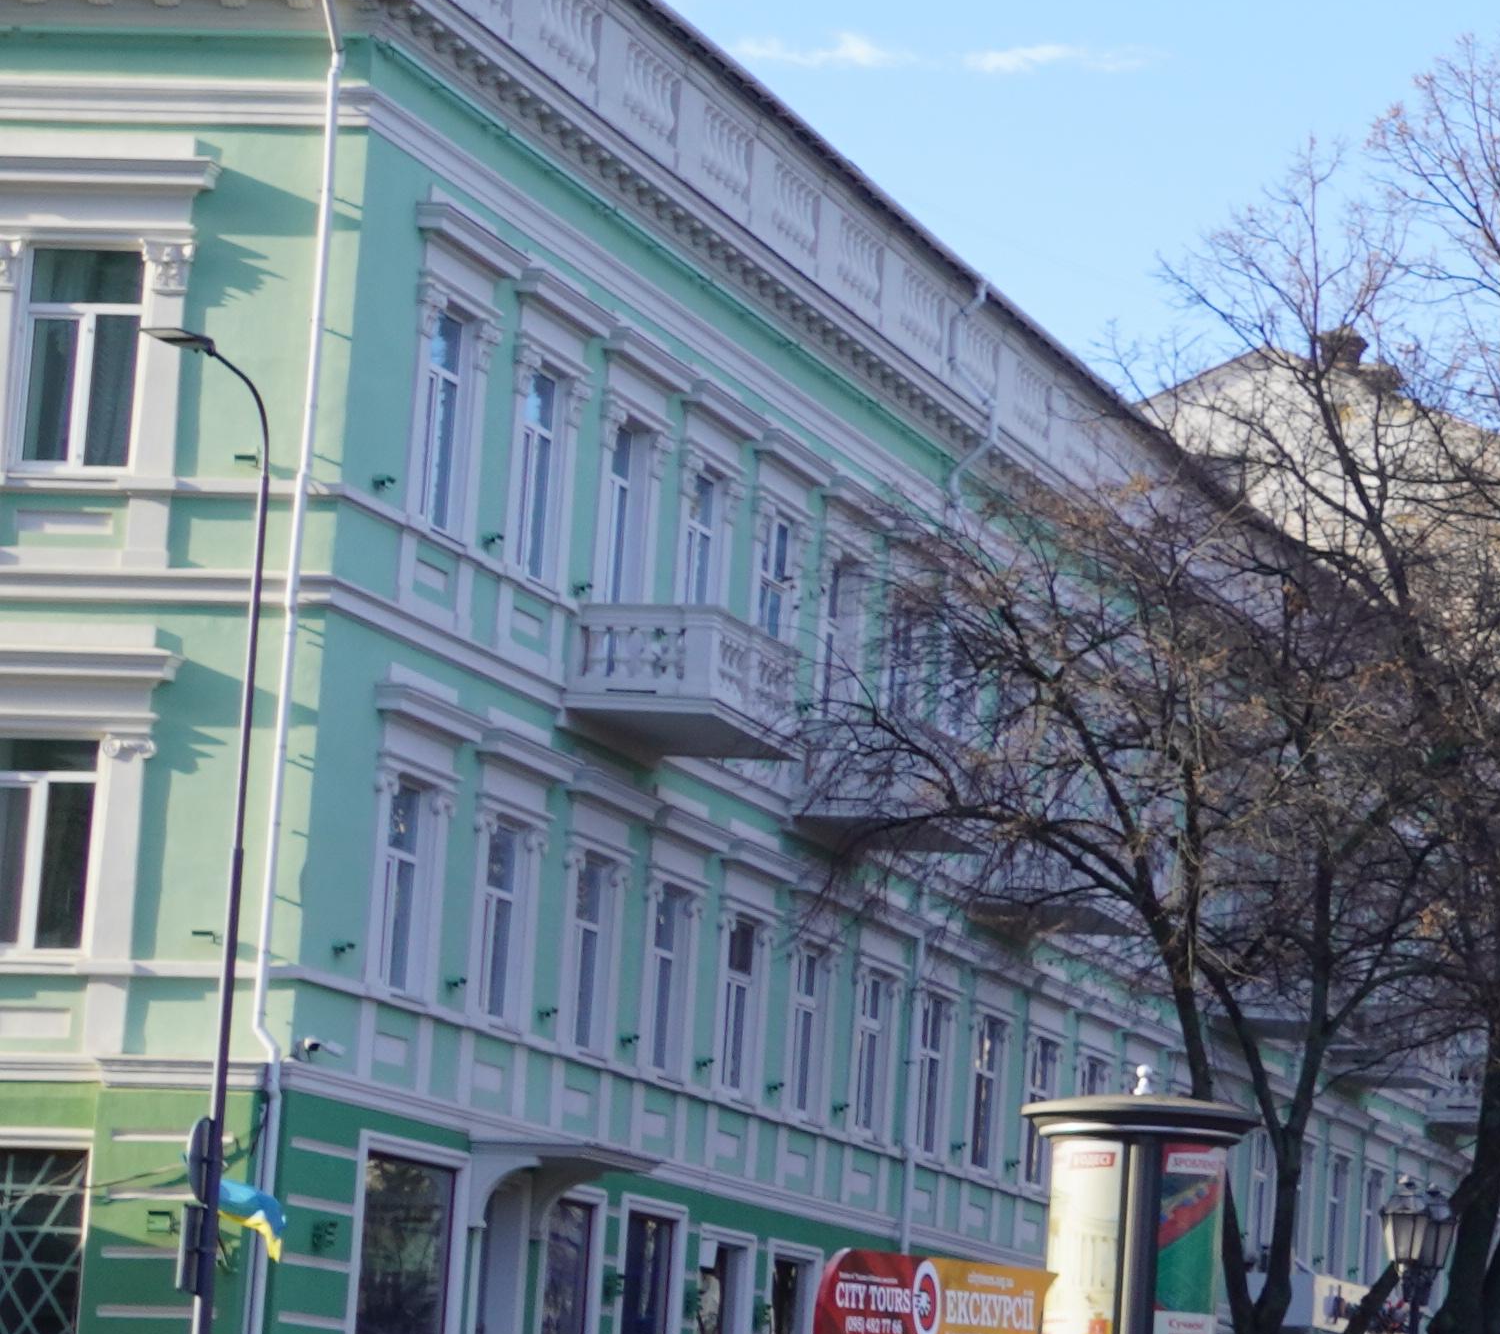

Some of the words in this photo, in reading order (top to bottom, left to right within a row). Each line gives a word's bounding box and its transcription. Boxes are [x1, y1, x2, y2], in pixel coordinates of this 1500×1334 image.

[835, 1281, 867, 1310] CITY
[868, 1285, 912, 1314] TOURS
[945, 1290, 1034, 1331] ЕКСКУРСІЇ
